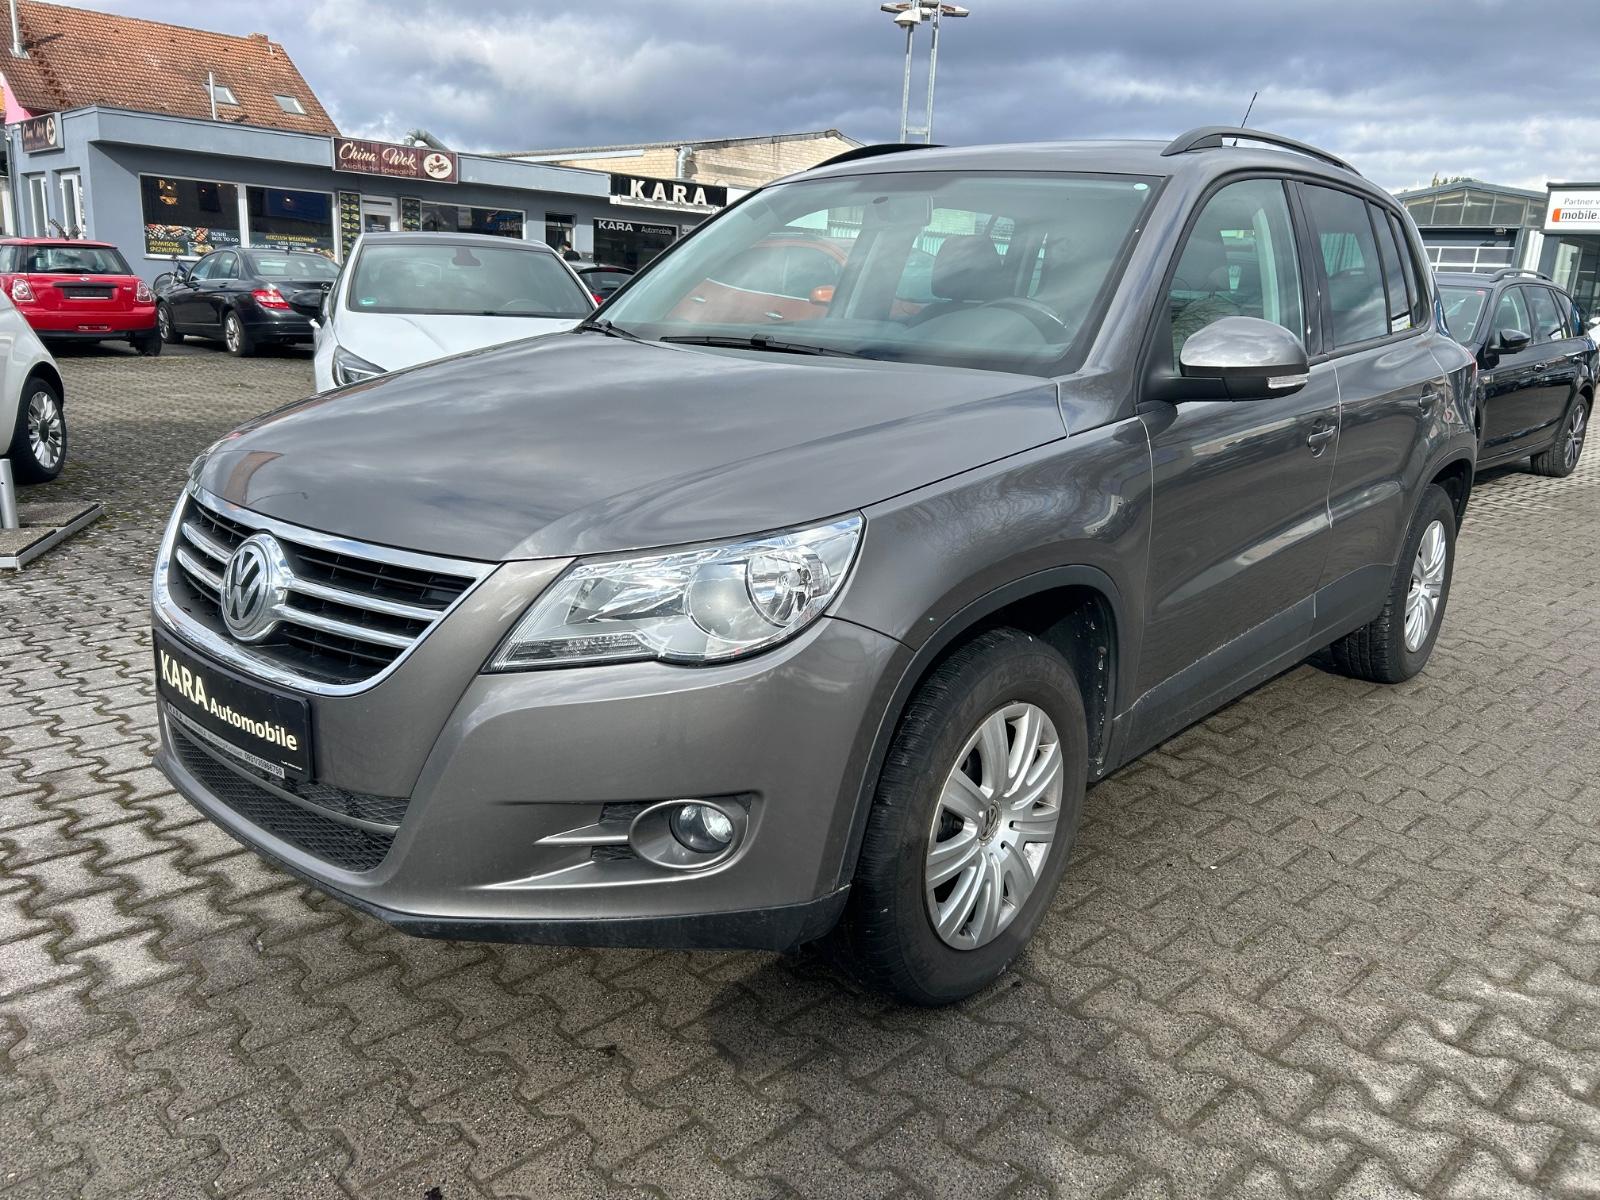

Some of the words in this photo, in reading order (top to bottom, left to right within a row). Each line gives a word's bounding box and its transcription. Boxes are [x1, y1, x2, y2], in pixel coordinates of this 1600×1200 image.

[339, 141, 378, 161] China
[382, 147, 417, 170] Wok
[630, 179, 707, 206] KARA
[1564, 197, 1593, 205] Partner
[598, 221, 634, 232] KARA
[641, 226, 672, 235] Automobile
[160, 650, 209, 711] KARA
[210, 697, 298, 751] Automobile
